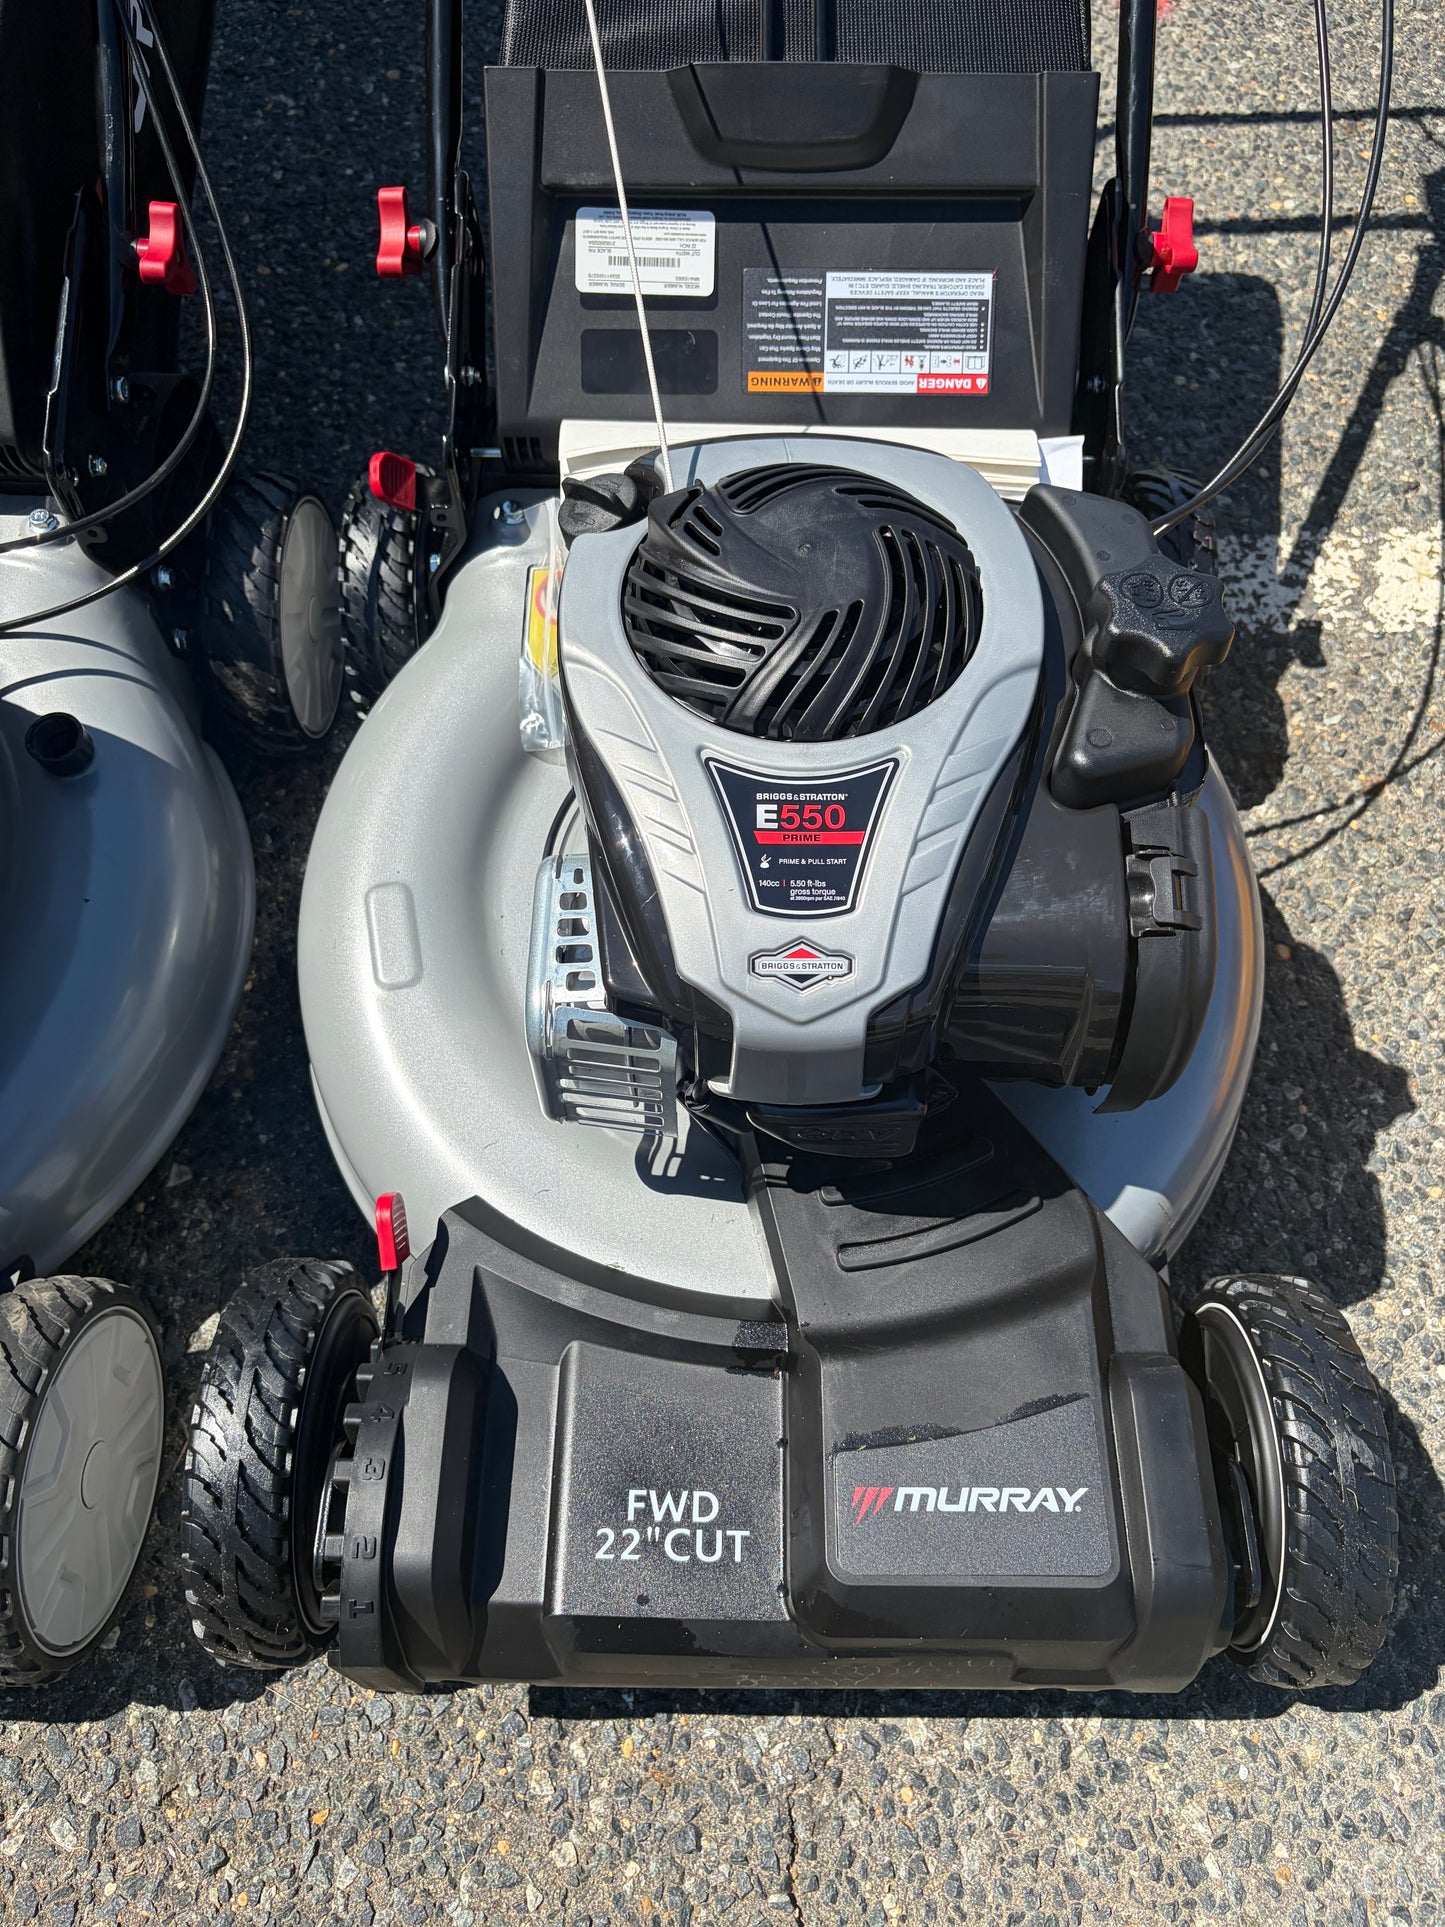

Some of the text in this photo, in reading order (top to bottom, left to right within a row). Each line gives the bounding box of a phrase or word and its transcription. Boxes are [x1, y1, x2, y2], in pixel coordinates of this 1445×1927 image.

[751, 377, 810, 386] WARNING
[919, 378, 972, 388] DANGER
[756, 804, 846, 830] E550
[782, 834, 821, 842] PRIME
[369, 1402, 395, 1424] 4
[362, 1458, 386, 1481] 3
[627, 1489, 720, 1523] FWD
[894, 1487, 1089, 1512] MURRAY
[352, 1535, 377, 1560] 2
[348, 1599, 374, 1619] 1
